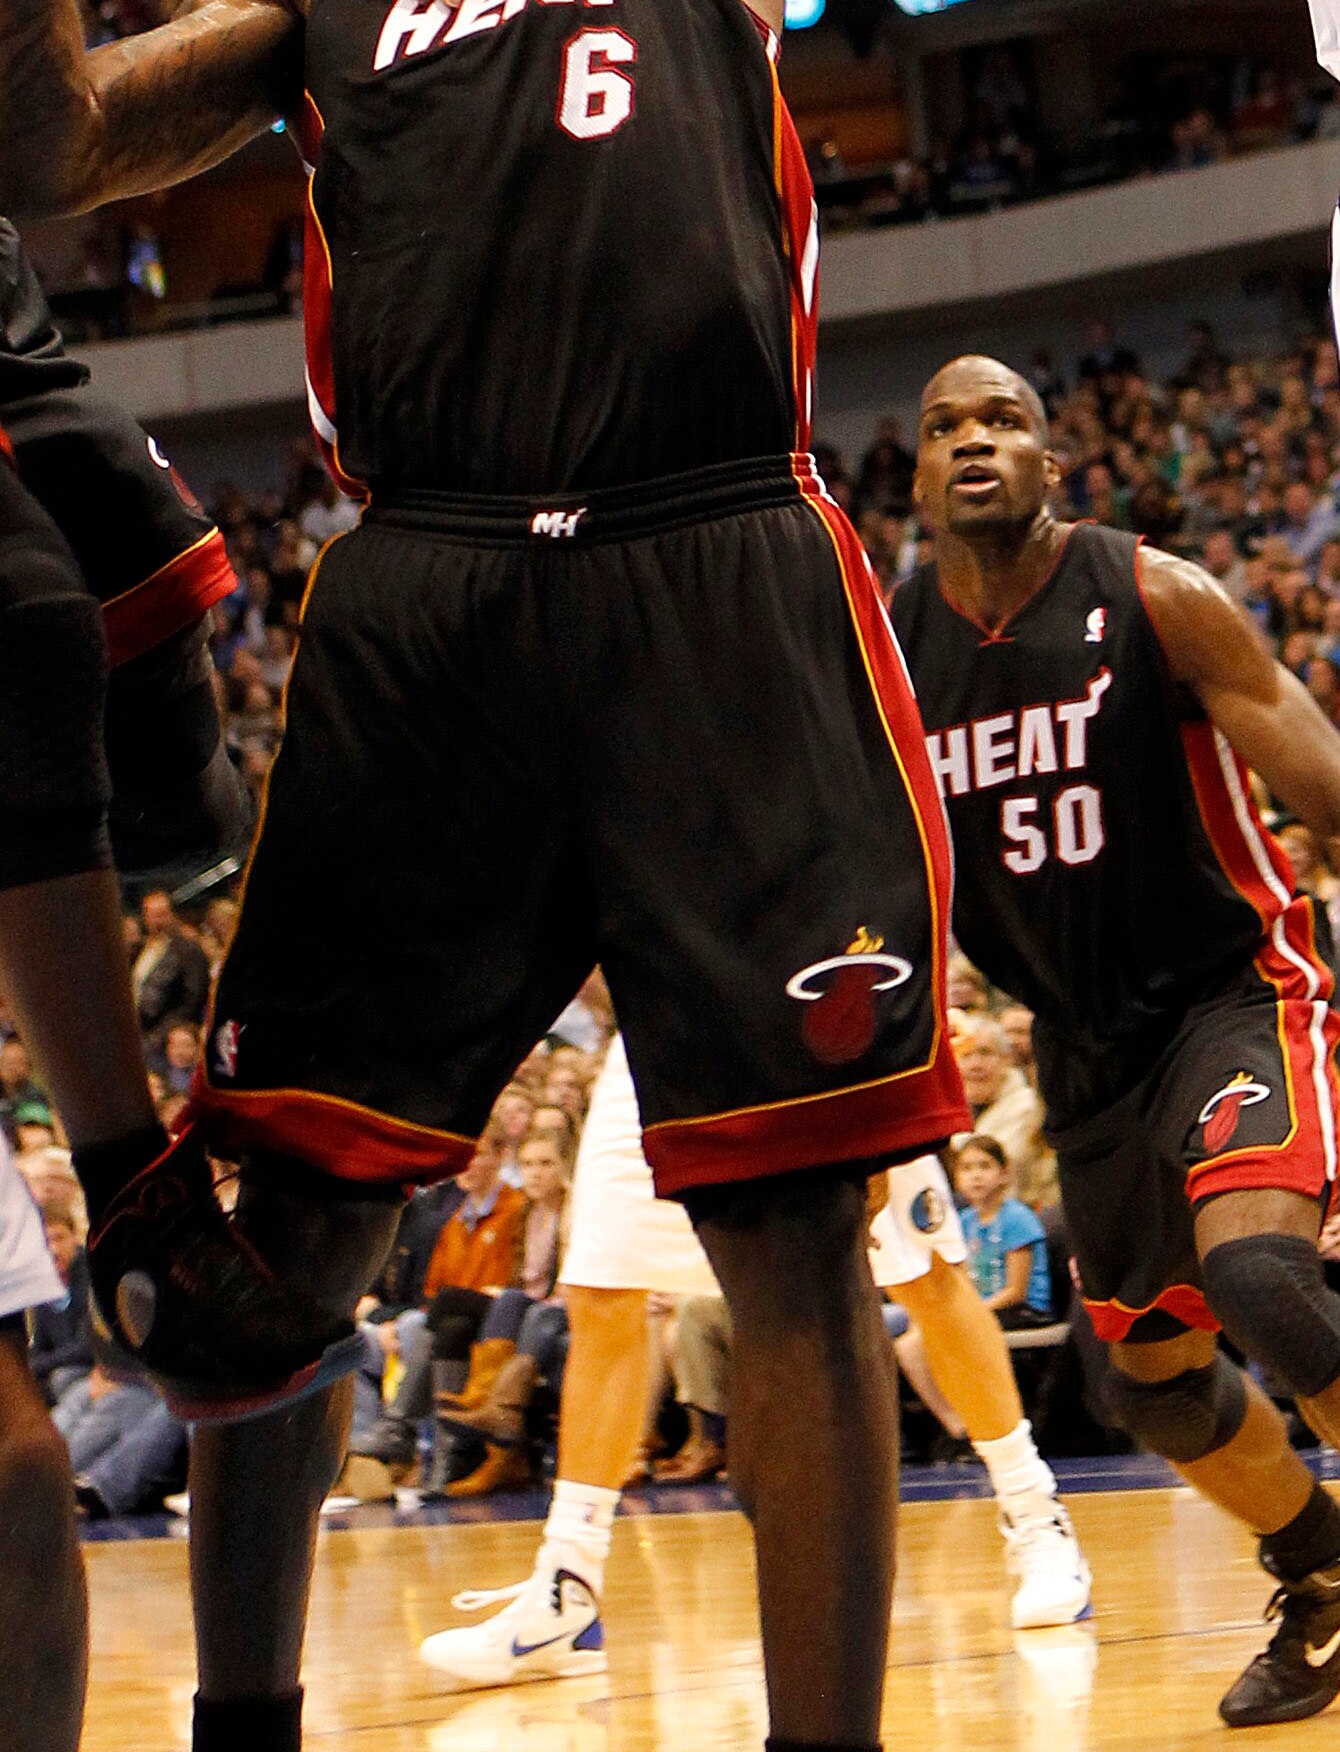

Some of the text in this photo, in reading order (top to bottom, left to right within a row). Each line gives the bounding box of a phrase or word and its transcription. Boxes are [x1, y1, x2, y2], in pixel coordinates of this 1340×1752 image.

[557, 26, 638, 140] 6
[924, 665, 1113, 798] HEAT
[1002, 784, 1105, 874] 50
